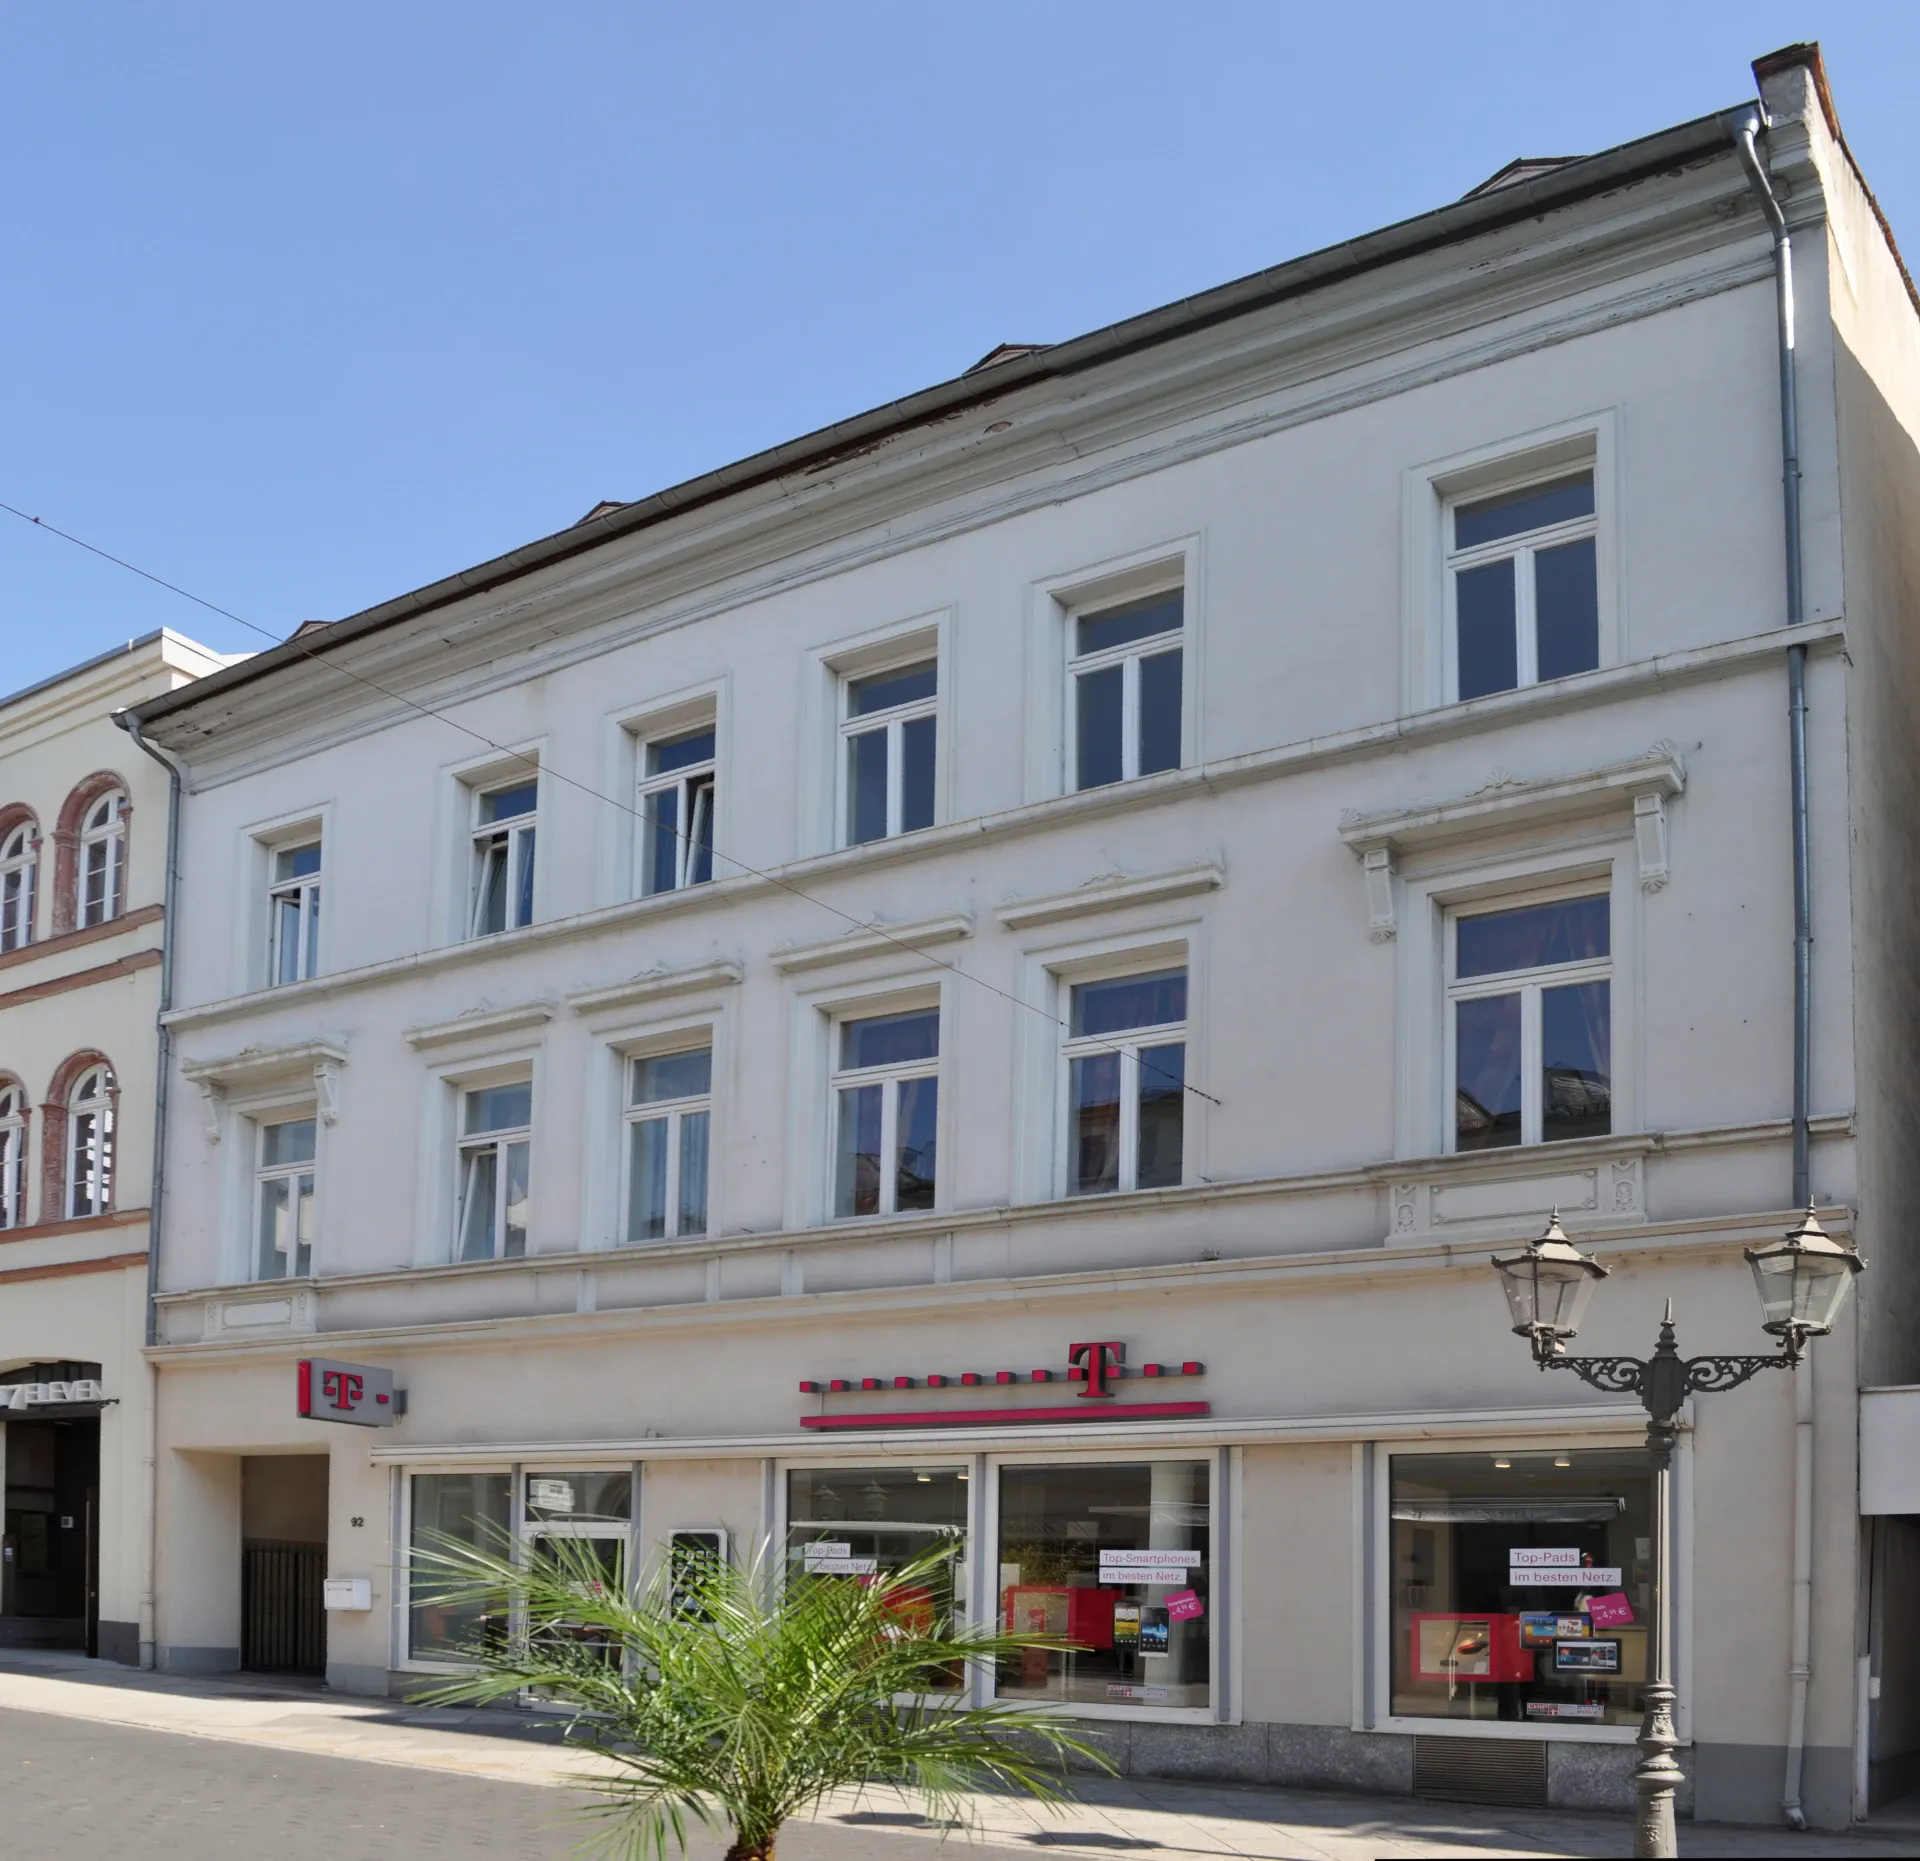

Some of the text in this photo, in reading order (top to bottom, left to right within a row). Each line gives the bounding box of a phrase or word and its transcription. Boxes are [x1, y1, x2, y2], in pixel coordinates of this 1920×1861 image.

[350, 1516, 364, 1528] 92
[1103, 1553, 1197, 1564] Top-Smartphones
[1514, 1552, 1576, 1564] Top-Pads
[1102, 1571, 1183, 1581] im besten Netz.
[1514, 1571, 1617, 1582] im besten Netz.
